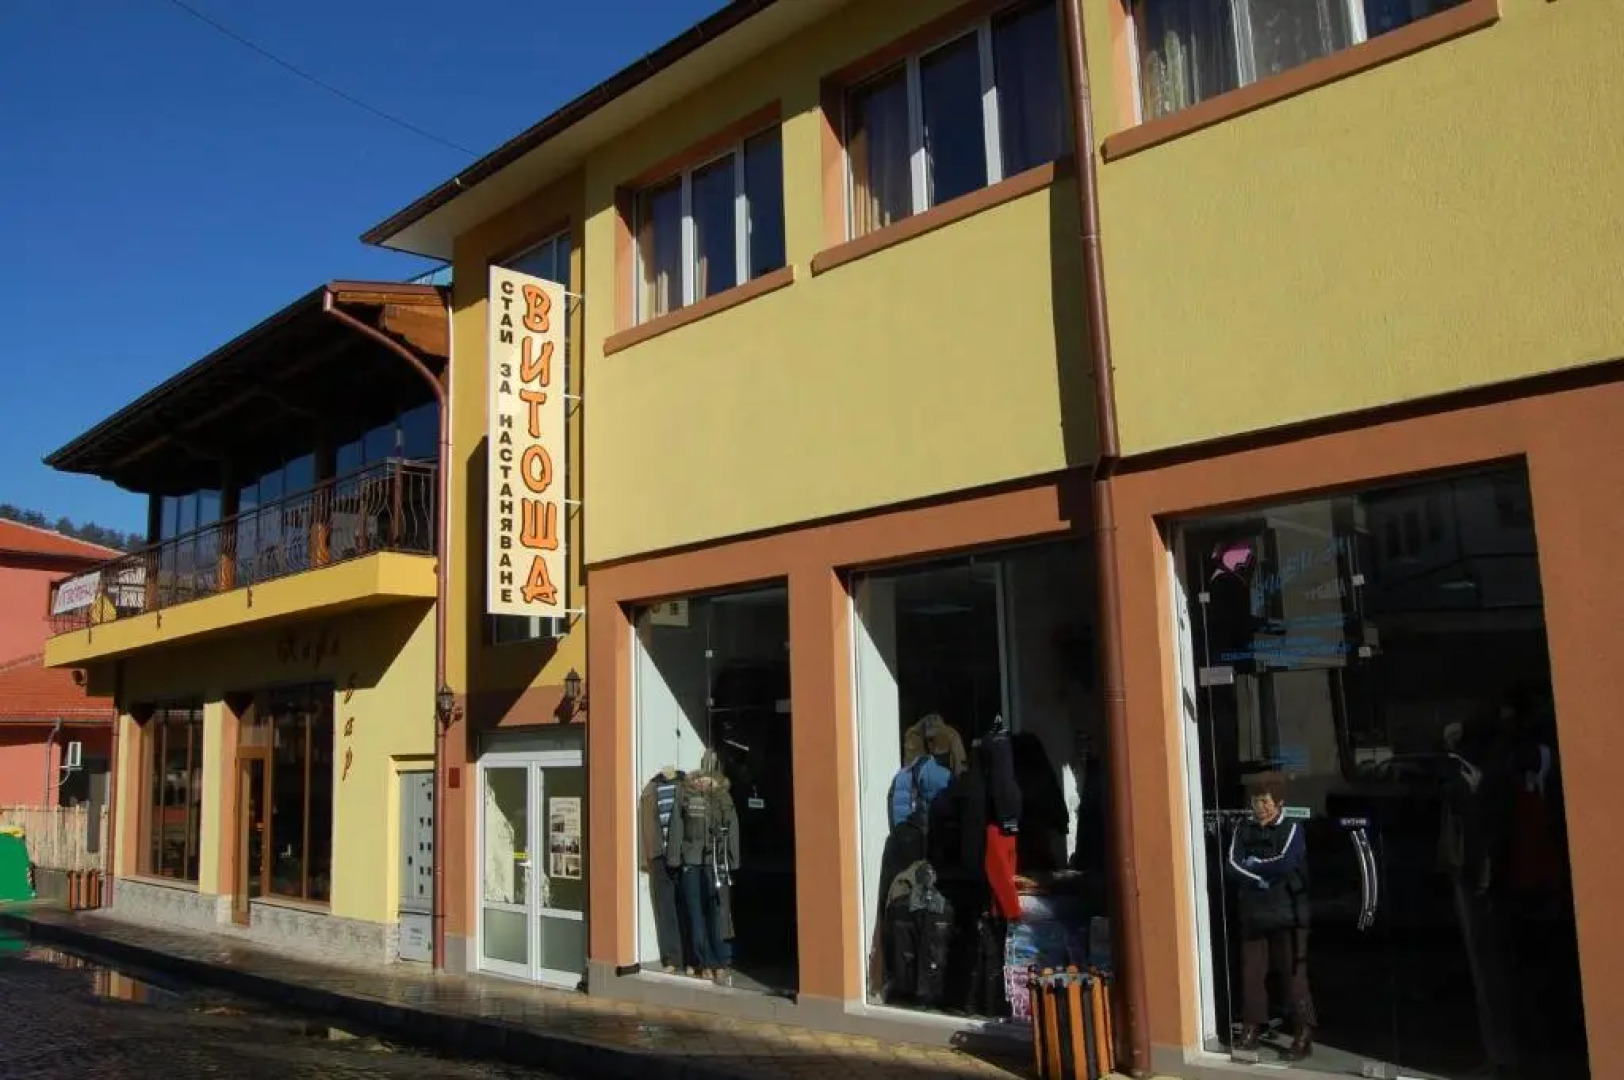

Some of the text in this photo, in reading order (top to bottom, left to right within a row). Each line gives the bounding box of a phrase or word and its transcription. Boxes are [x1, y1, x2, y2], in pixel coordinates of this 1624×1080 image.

[499, 281, 513, 603] СТАИ ЗА НАСТАНЯВАНЕ
[519, 284, 559, 606] ВИТОША
